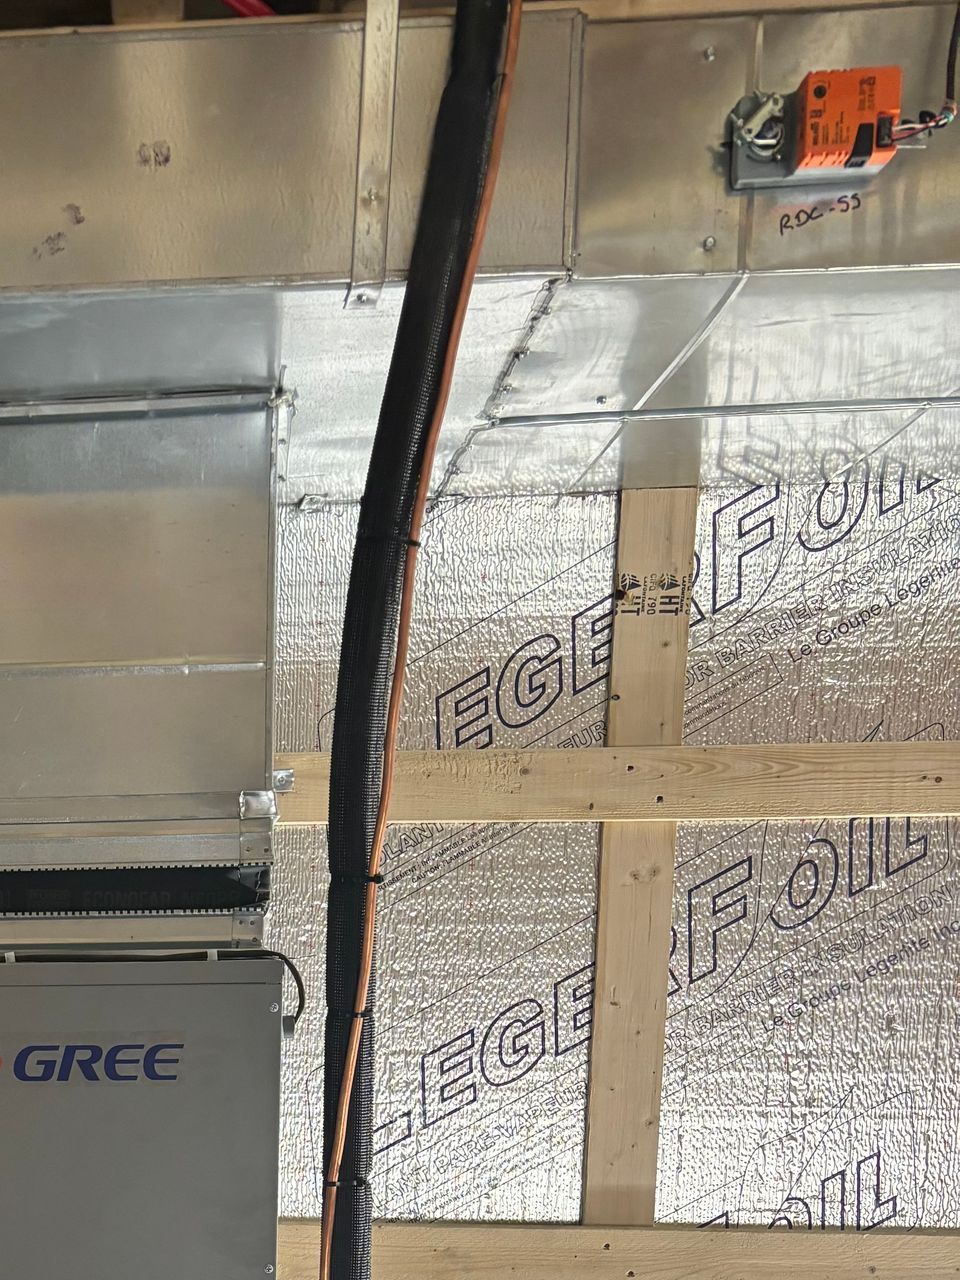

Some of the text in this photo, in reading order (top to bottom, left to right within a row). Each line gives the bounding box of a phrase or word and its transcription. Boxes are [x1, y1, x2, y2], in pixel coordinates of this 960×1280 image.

[647, 596, 657, 615] 790
[659, 595, 680, 616] HT
[714, 593, 828, 669] BARRIER
[787, 643, 812, 663] Le
[815, 603, 882, 646] Groupe
[692, 967, 800, 1036] BARRIER
[800, 884, 955, 980] INSULATION
[761, 1014, 785, 1033] Le
[787, 979, 852, 1018] Groupe
[855, 935, 931, 983] Legerlite
[13, 1043, 185, 1082] GREE
